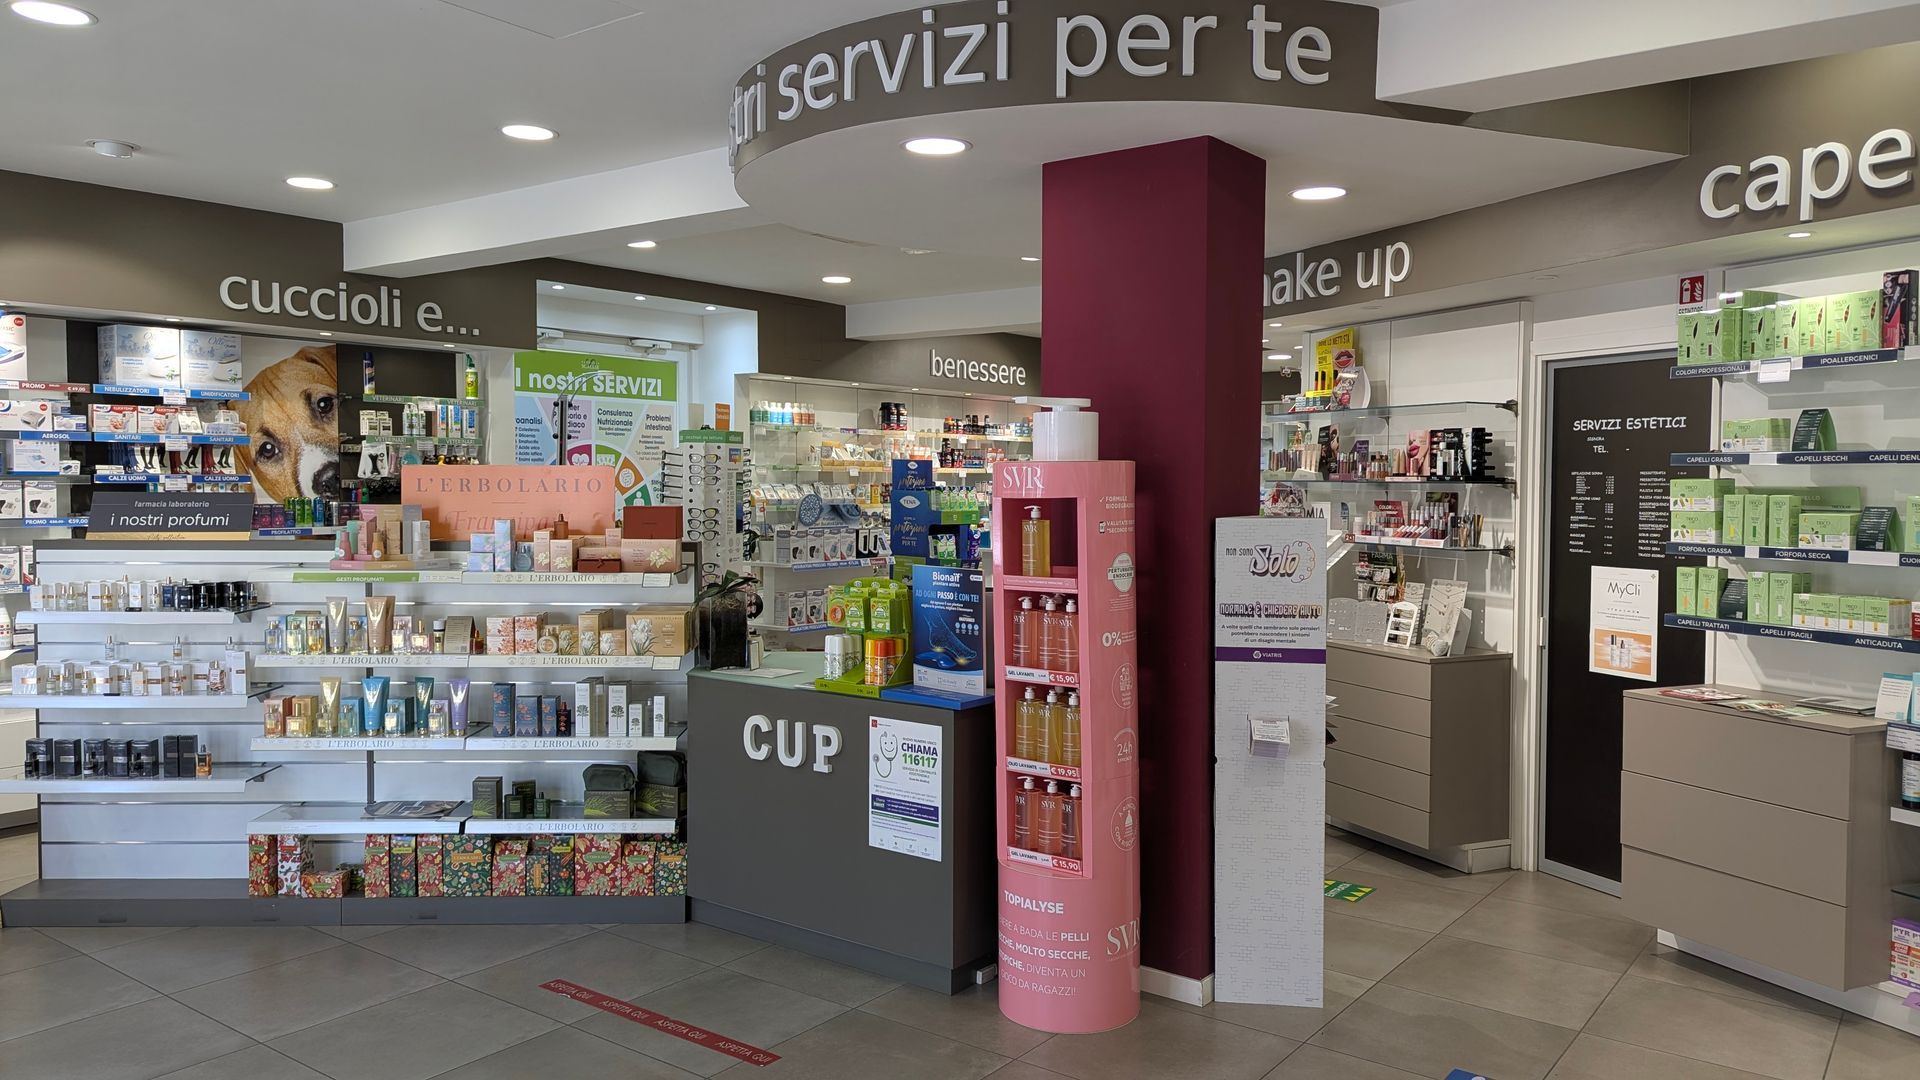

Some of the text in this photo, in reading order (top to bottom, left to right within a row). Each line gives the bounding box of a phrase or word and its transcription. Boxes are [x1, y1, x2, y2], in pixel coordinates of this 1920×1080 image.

[778, 0, 1009, 120] servizi
[1055, 12, 1217, 98] per
[1248, 4, 1332, 85] te
[1356, 240, 1414, 297] up
[219, 276, 400, 328] cuccioli
[1821, 354, 1878, 364] IPOALLERGENICI
[930, 349, 1026, 386] benessere
[1699, 365, 1746, 374] PROFESSIONALI
[516, 368, 662, 397] I nostri SERVIZI
[598, 408, 632, 417] Consulenza
[1573, 417, 1687, 431] SERVIZI ESTETICI
[1003, 465, 1044, 489] SVR
[111, 514, 230, 528] i nostri profumi
[937, 591, 954, 600] PASSO
[1220, 603, 1254, 618] NORMALE
[1263, 604, 1298, 618] CHIEDERE
[1299, 604, 1322, 618] AIUTO
[1701, 621, 1729, 630] TRATTATI
[1102, 632, 1122, 647] 0%
[1787, 631, 1813, 639] FRAGILI
[1855, 638, 1903, 649] ANTICADUTA
[743, 714, 842, 773] CUP
[901, 742, 938, 756] CHIAMA
[902, 753, 937, 768] 116117
[1058, 768, 1076, 777] 19,95
[1059, 860, 1078, 870] 15,90
[1004, 890, 1064, 914] TOPIALYSE
[1020, 926, 1043, 940] BADA
[1046, 932, 1057, 941] LE
[1061, 932, 1089, 942] PELLI
[1016, 943, 1090, 961] MOLTO SECCHE,
[1027, 963, 1086, 978] DIVENTA UN
[550, 982, 592, 1000] ASPETTA QUI
[1019, 980, 1030, 989] DA
[599, 1000, 647, 1019] ASPETTA QUI
[654, 1019, 706, 1040] ASPETTA QUI
[715, 1041, 771, 1064] ASPETTA QUI
